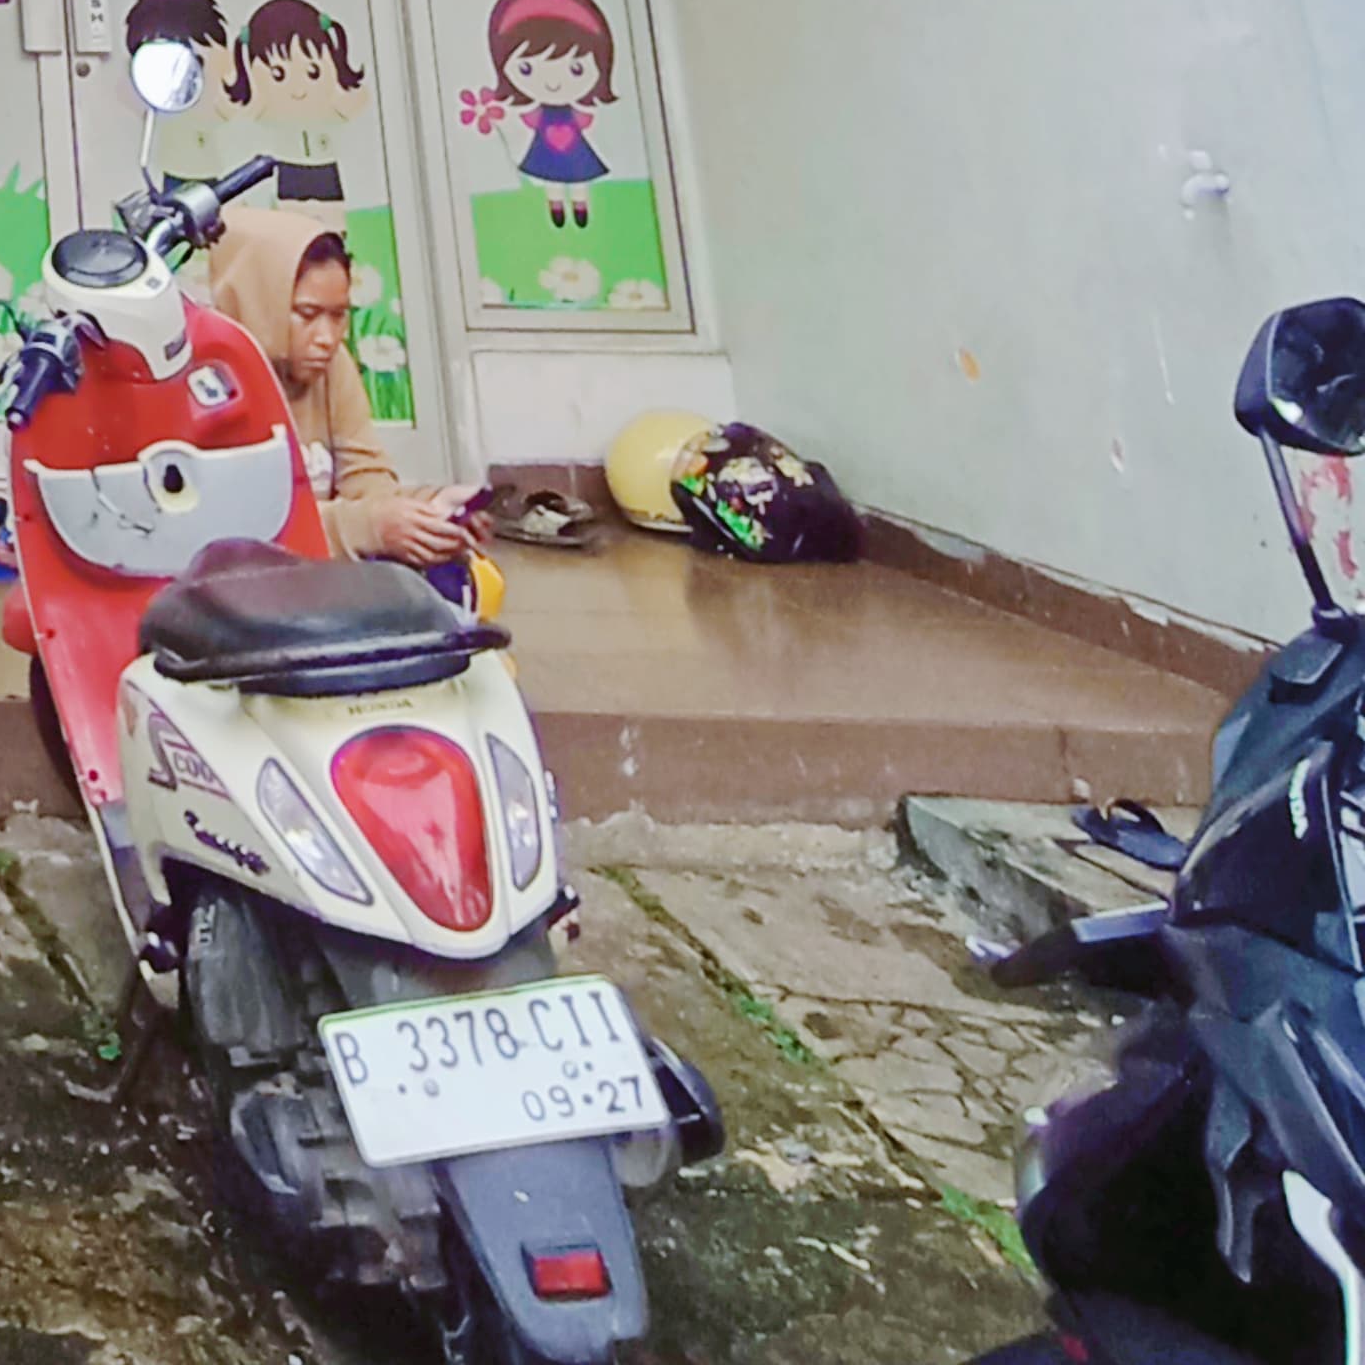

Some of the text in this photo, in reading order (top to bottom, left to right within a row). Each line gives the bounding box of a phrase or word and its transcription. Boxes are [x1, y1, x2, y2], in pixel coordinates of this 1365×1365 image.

[333, 990, 622, 1087] B 3378 CII
